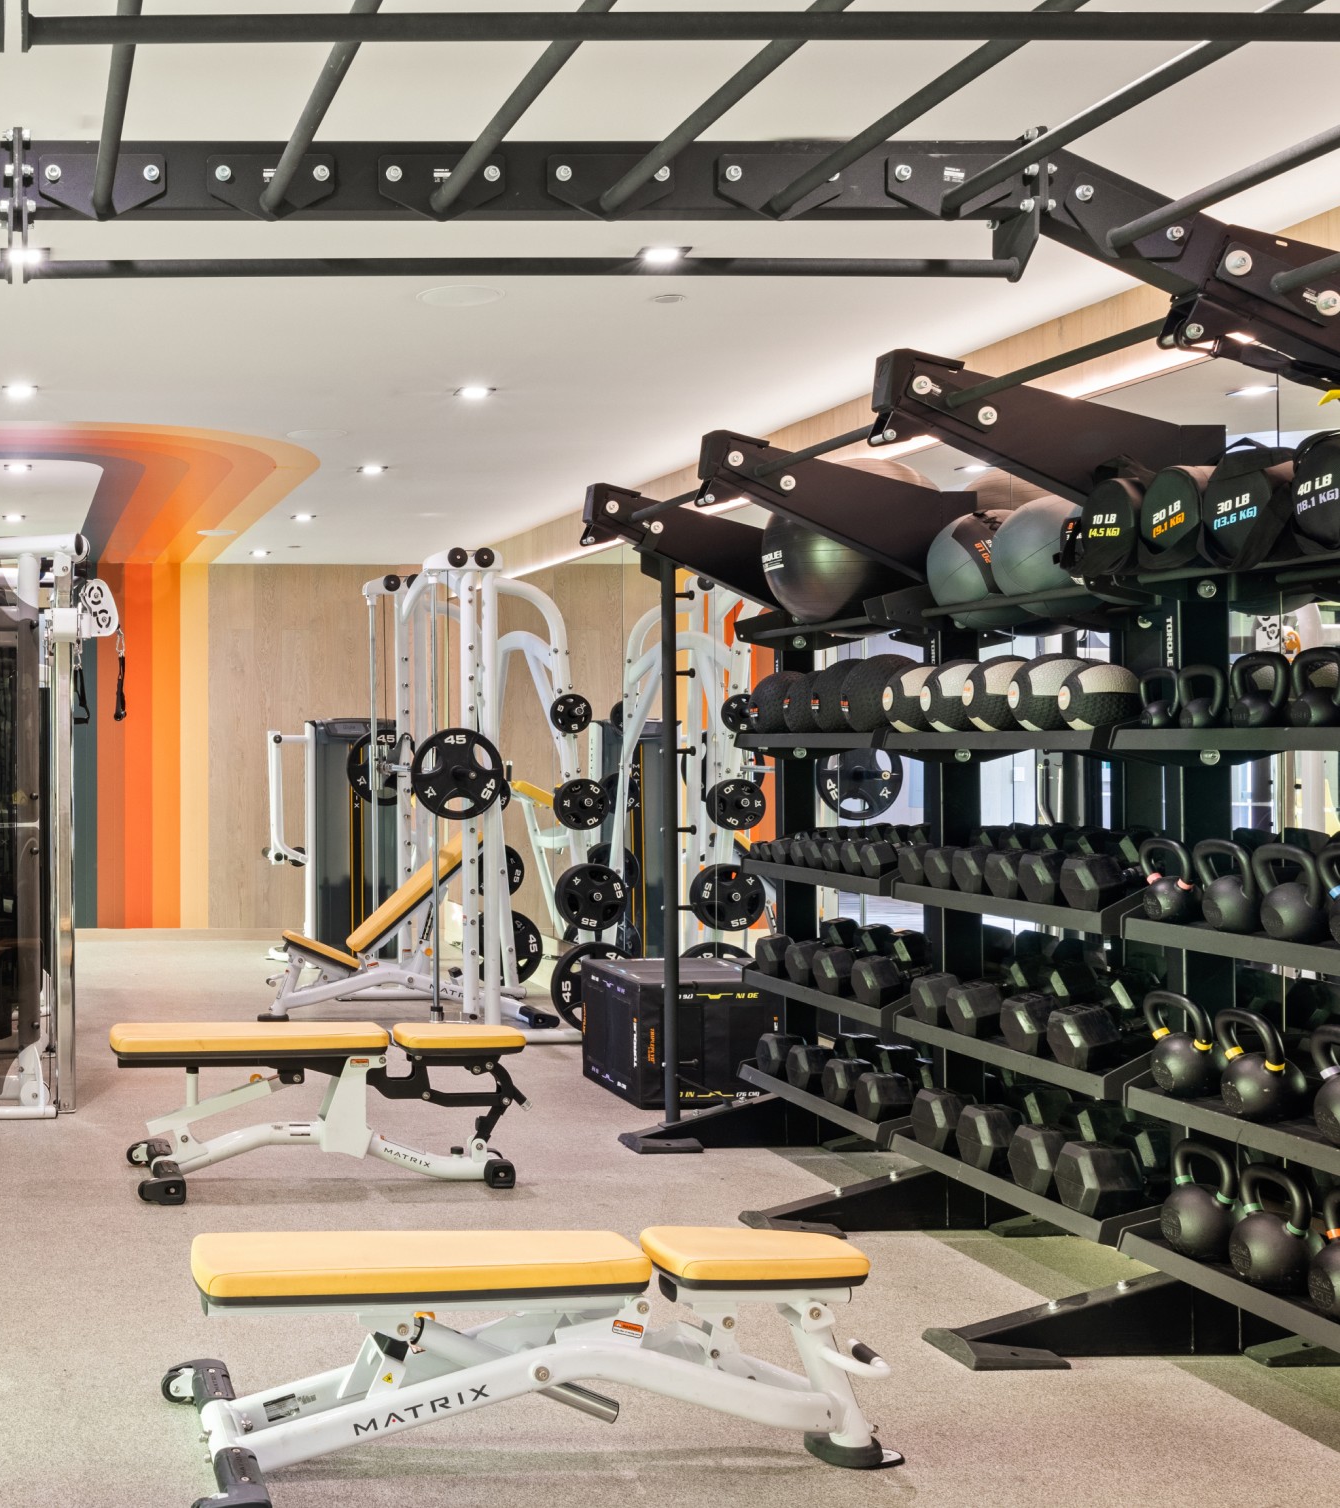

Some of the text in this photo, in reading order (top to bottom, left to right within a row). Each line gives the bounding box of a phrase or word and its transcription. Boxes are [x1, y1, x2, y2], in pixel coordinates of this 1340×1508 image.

[1297, 480, 1311, 496] 40
[1216, 492, 1250, 515] 30 LB
[1092, 514, 1117, 524] 10 LB
[1152, 500, 1181, 525] 20 LB
[1213, 505, 1258, 530] (13.6 KG)
[1088, 528, 1104, 538] (4.5
[1105, 527, 1120, 536] KG)
[1152, 511, 1185, 538] (9.1 KG)
[377, 734, 395, 743] 45
[444, 734, 466, 744] 45
[480, 778, 496, 800] 45
[590, 784, 600, 794] 10
[586, 816, 598, 825] 10
[514, 868, 522, 883] 25
[613, 882, 624, 899] 25
[581, 917, 597, 926] 25
[528, 934, 538, 953] 45
[562, 980, 572, 1003] 45
[384, 1147, 430, 1168] MATRIX
[353, 1384, 490, 1436] MATRIX
